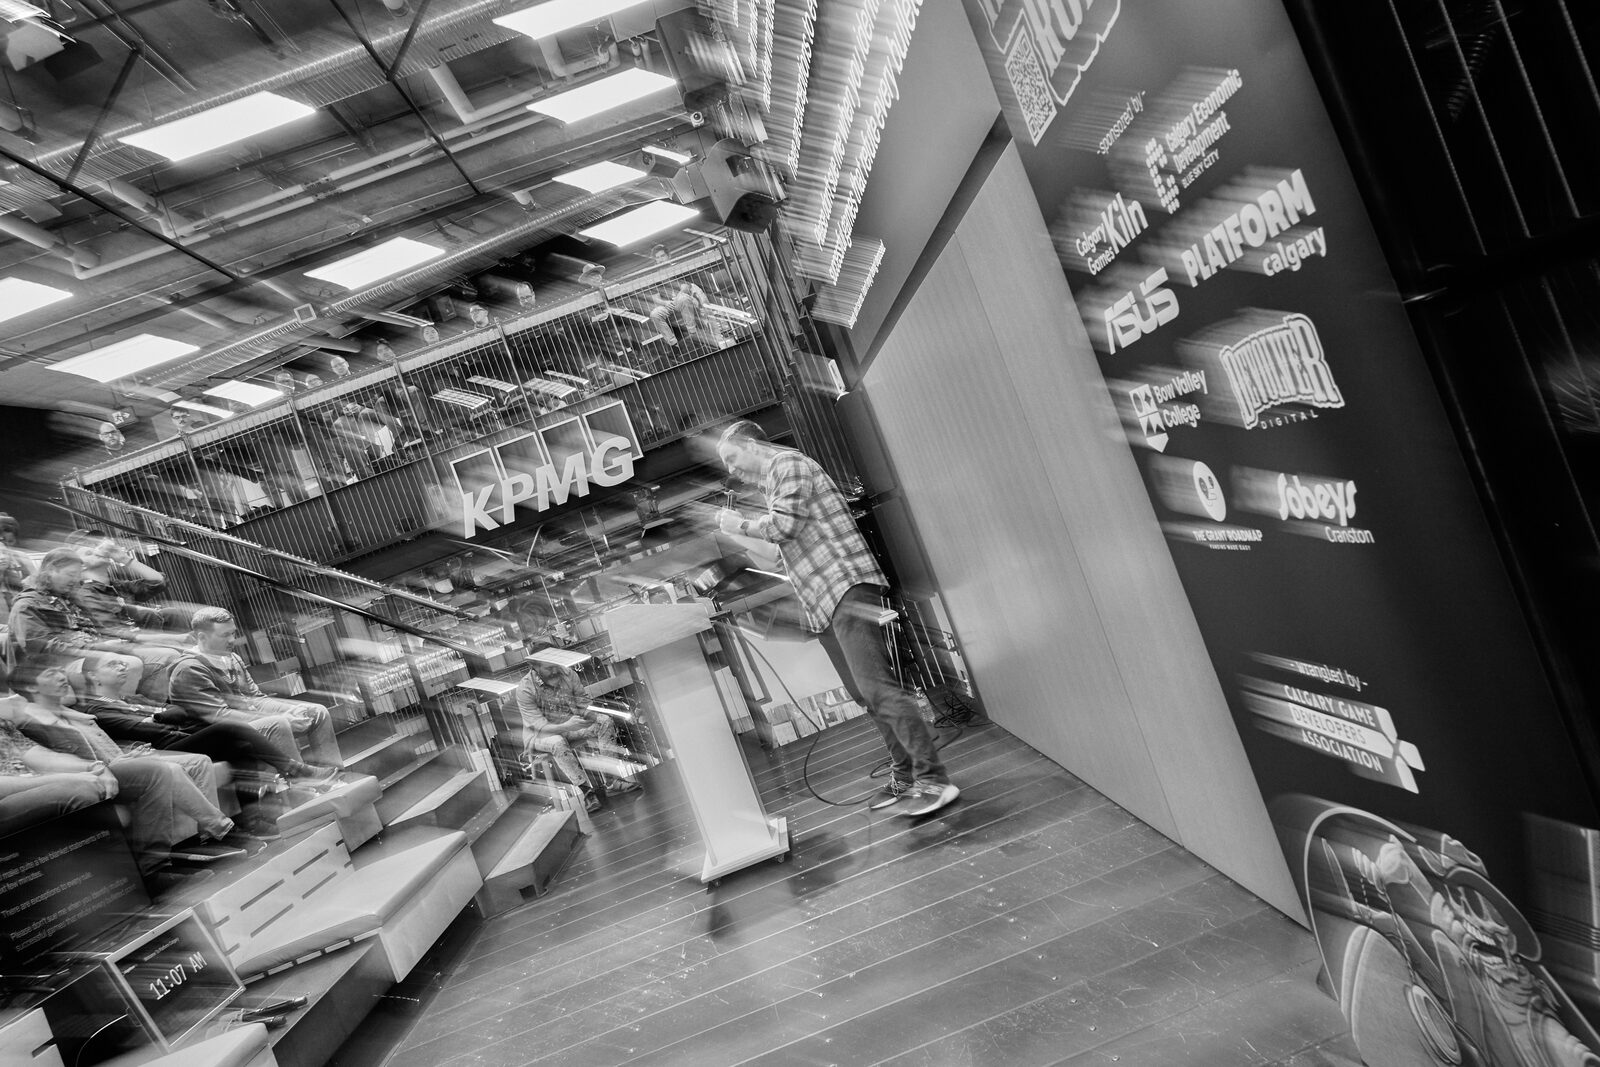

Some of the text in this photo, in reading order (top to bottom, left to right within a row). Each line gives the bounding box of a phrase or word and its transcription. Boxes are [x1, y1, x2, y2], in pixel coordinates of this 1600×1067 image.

[1100, 102, 1134, 154] sponsored
[1165, 68, 1242, 152] Calgary Economic
[1172, 110, 1231, 174] Development
[1076, 221, 1108, 256] Calgary
[1100, 192, 1149, 254] Kiln
[1180, 168, 1316, 288] PLATFORM
[1087, 245, 1116, 276] Games
[1262, 226, 1327, 276] calgary
[1104, 266, 1180, 355] ASUS
[1152, 370, 1208, 404] Bow Valley
[1219, 313, 1345, 430] DEVOLVER
[1162, 404, 1201, 428] College
[1261, 408, 1319, 430] DIGITAL
[462, 436, 635, 540] KPMG
[1277, 472, 1357, 526] Sobeys
[1193, 529, 1263, 542] THE GRANT ROADMAP
[1324, 526, 1376, 544] Cranston
[1296, 661, 1362, 692] wrangled by
[1284, 684, 1376, 728] CALGARY GAME
[1293, 706, 1366, 745] DEVELOPERS
[1301, 728, 1384, 773] ASSOCIATION
[150, 964, 186, 1000] 11:07
[188, 951, 208, 973] AM
